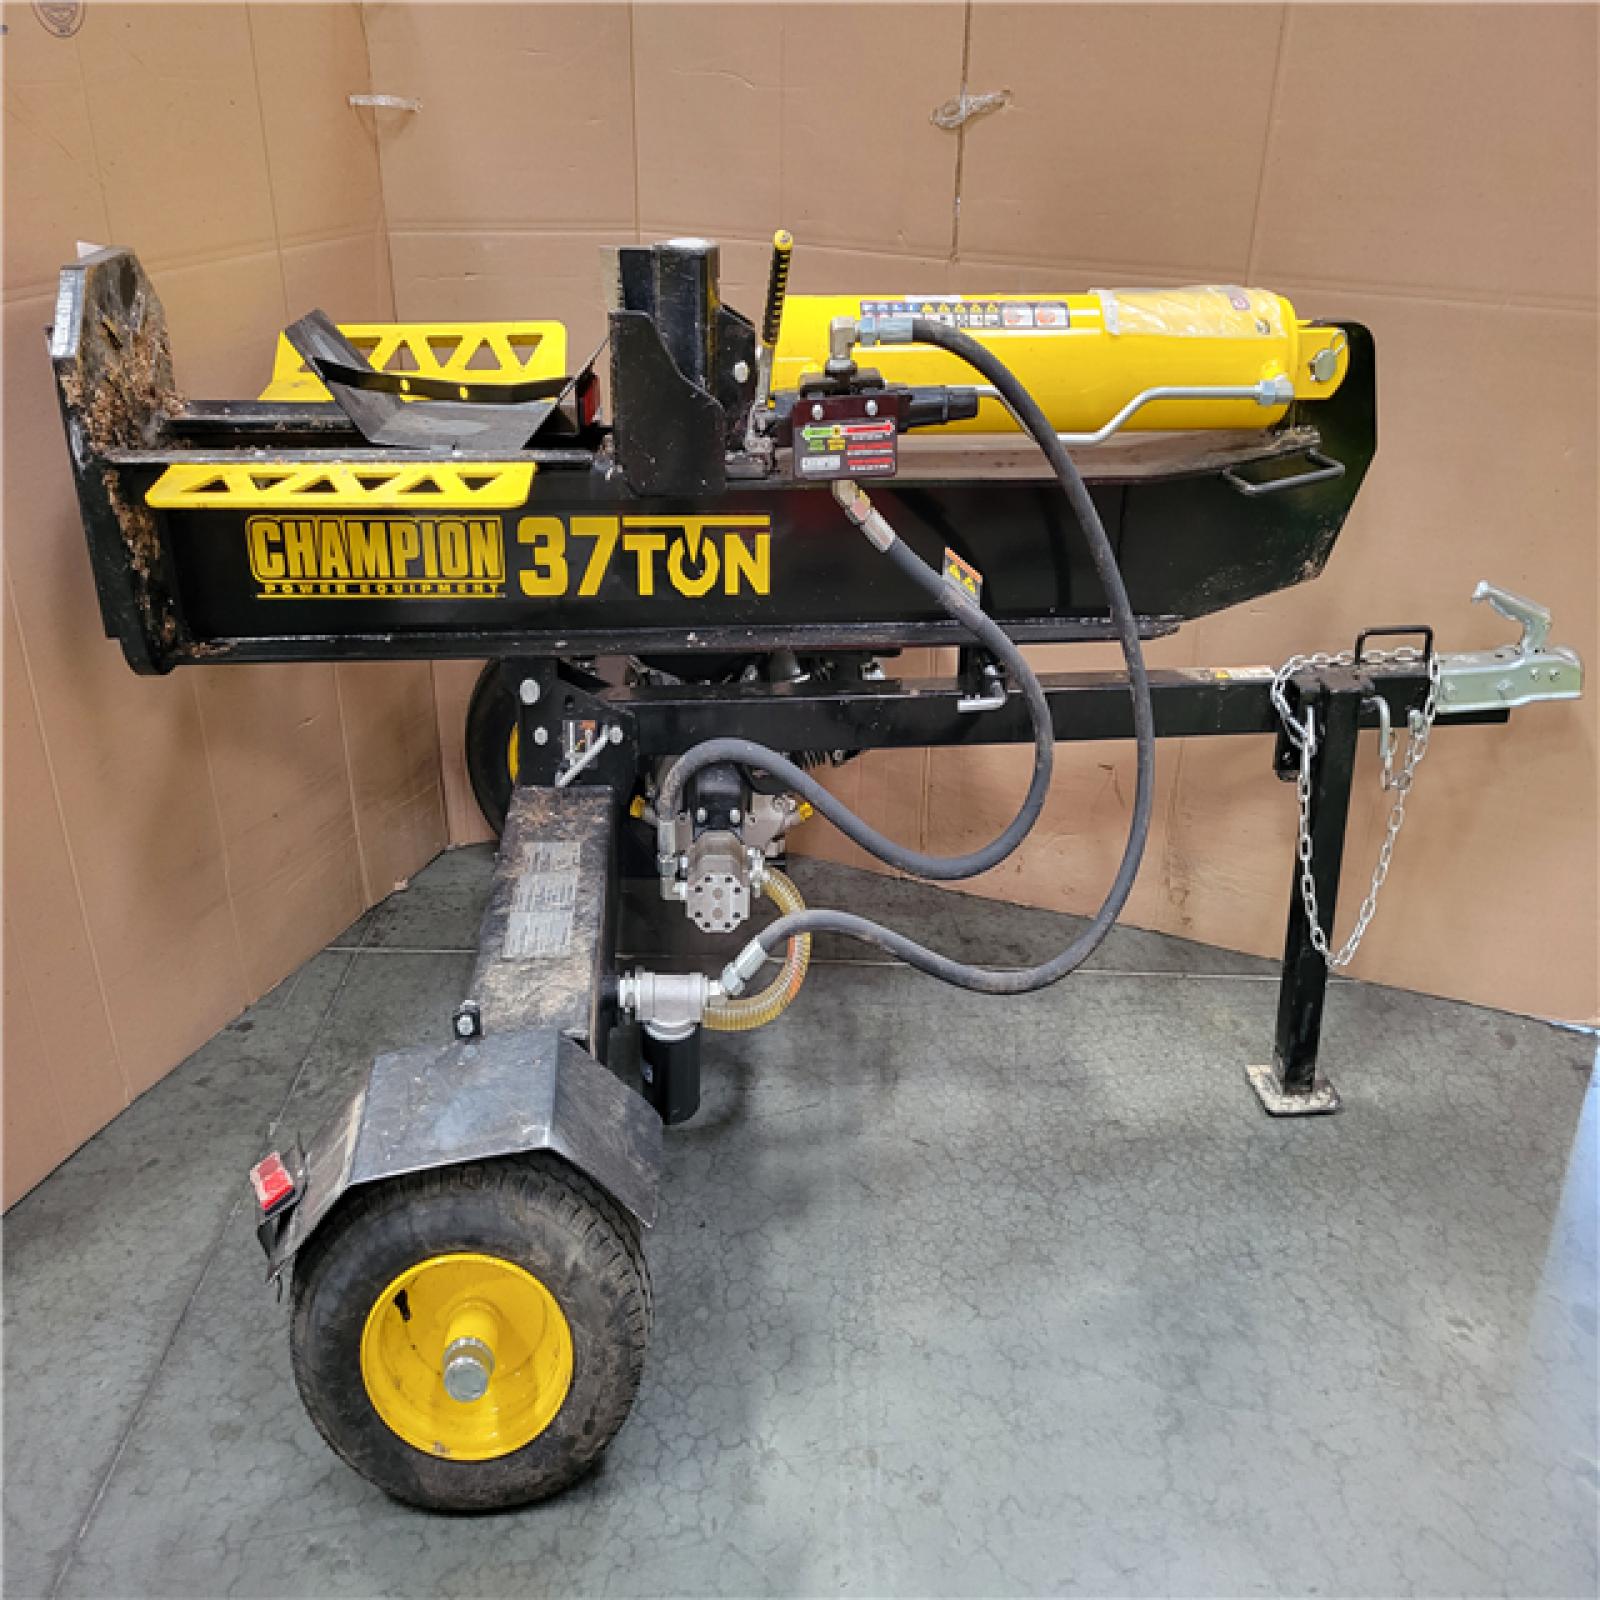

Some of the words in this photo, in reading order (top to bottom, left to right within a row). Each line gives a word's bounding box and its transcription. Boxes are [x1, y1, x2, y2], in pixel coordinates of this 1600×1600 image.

[250, 519, 499, 579] CHAMPION
[517, 515, 620, 596] 37
[622, 528, 770, 597] TON
[264, 583, 347, 595] POWER
[359, 583, 499, 595] EQUIPMENT
